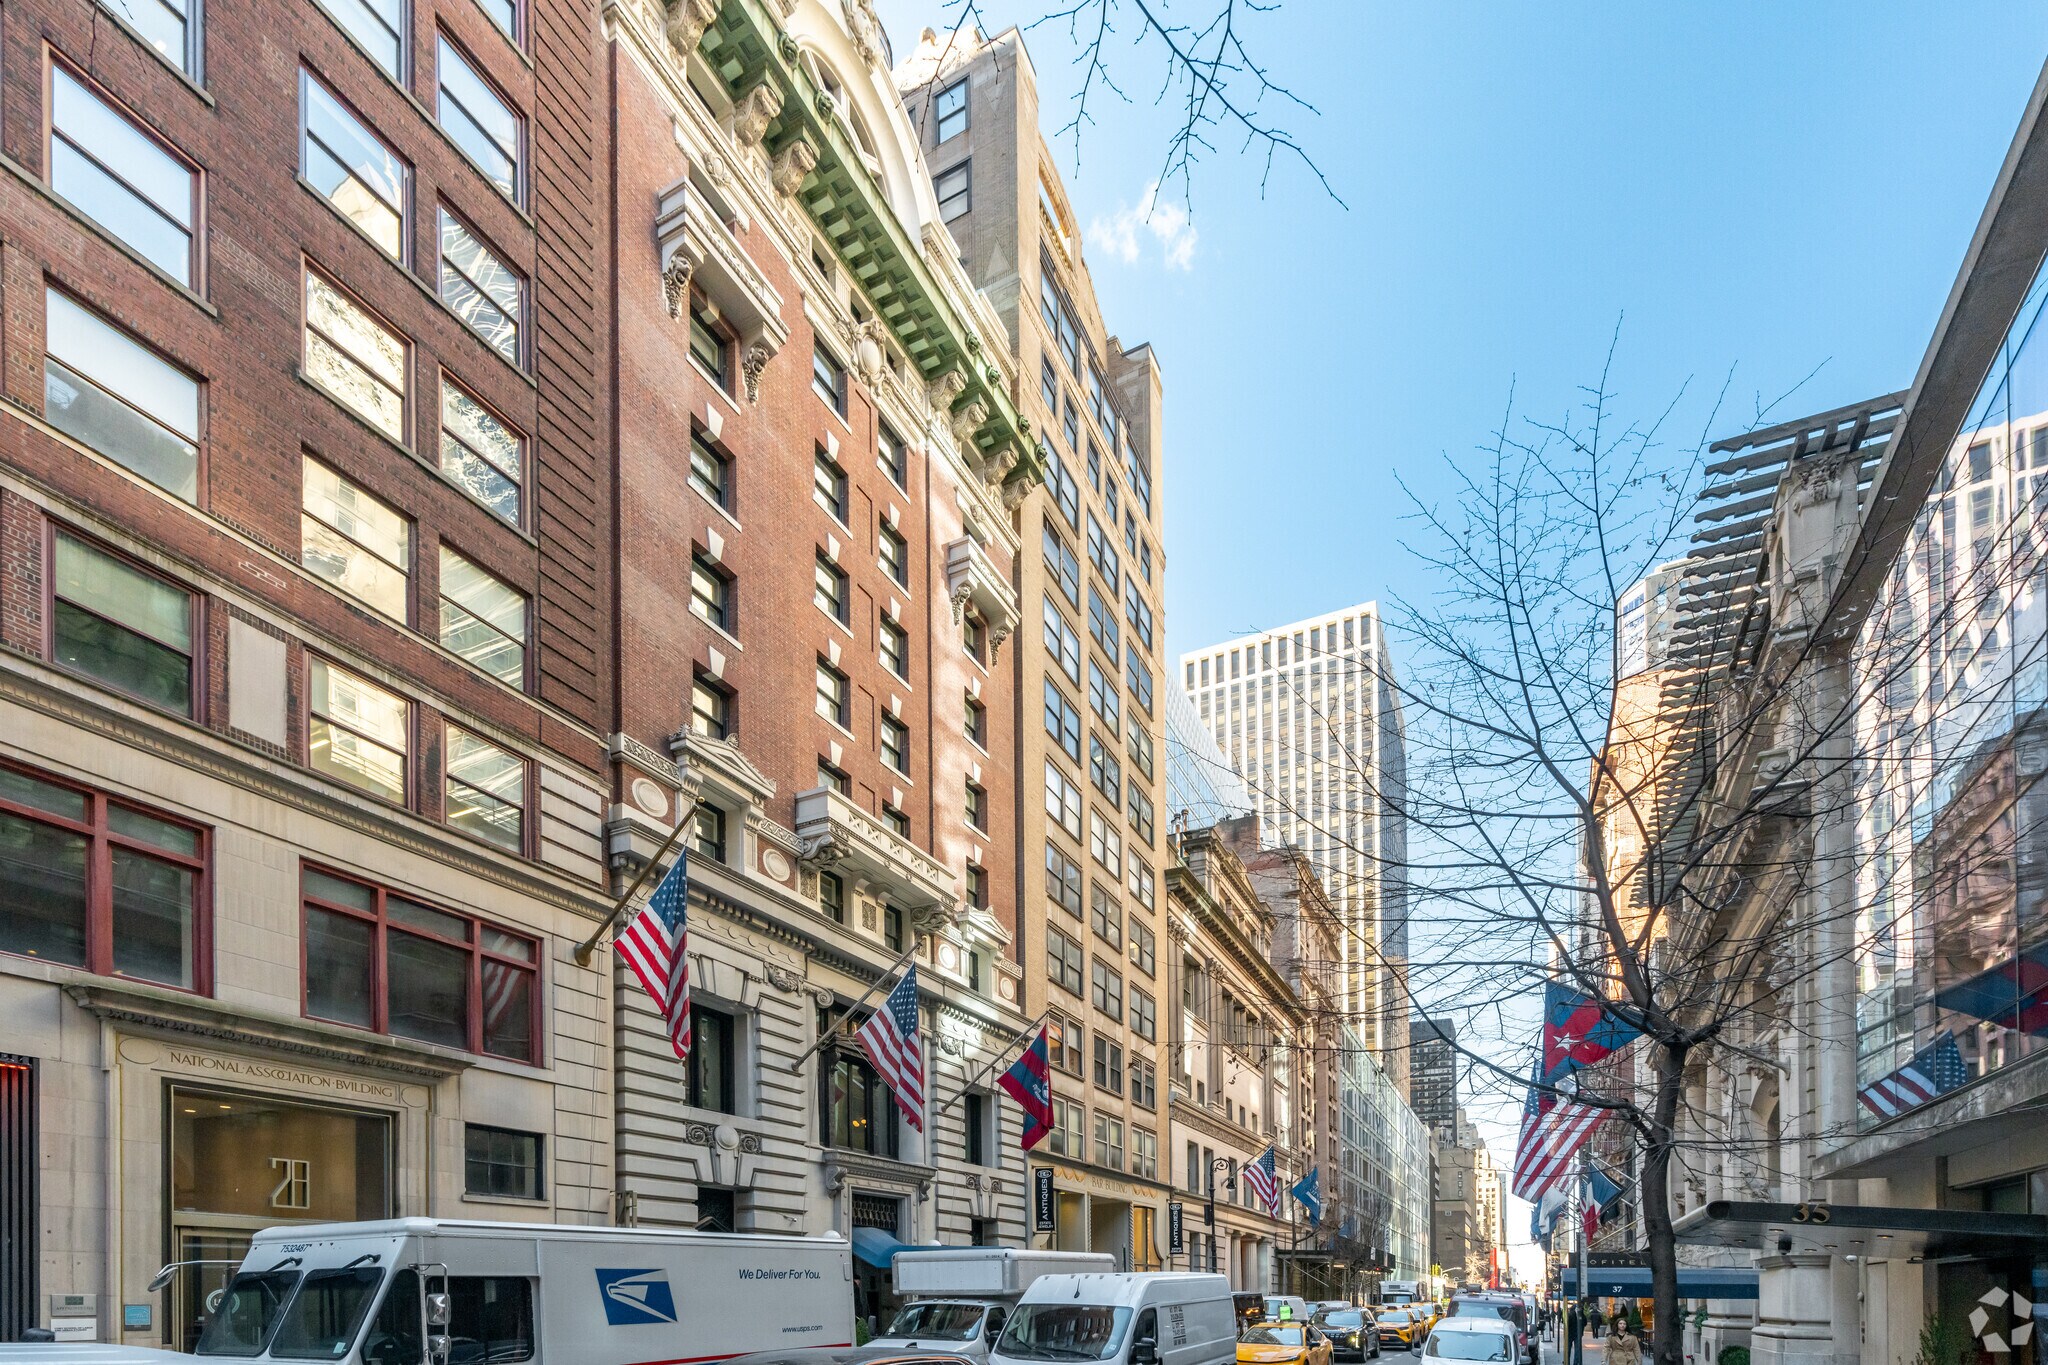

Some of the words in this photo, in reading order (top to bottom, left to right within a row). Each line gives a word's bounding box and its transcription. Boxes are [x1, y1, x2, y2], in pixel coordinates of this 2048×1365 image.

[170, 1051, 243, 1074] NATIONAL
[245, 1065, 331, 1088] ASSOCIATION
[1091, 1176, 1104, 1190] BAR
[1105, 1181, 1128, 1194] BUILDING
[1041, 1178, 1049, 1221] ANTIQUES
[1791, 1203, 1830, 1223] 35
[739, 1269, 754, 1279] We
[756, 1269, 787, 1279] Deliver
[789, 1269, 803, 1279] For
[804, 1269, 821, 1279] You.
[782, 1325, 823, 1334] www.usps.com
